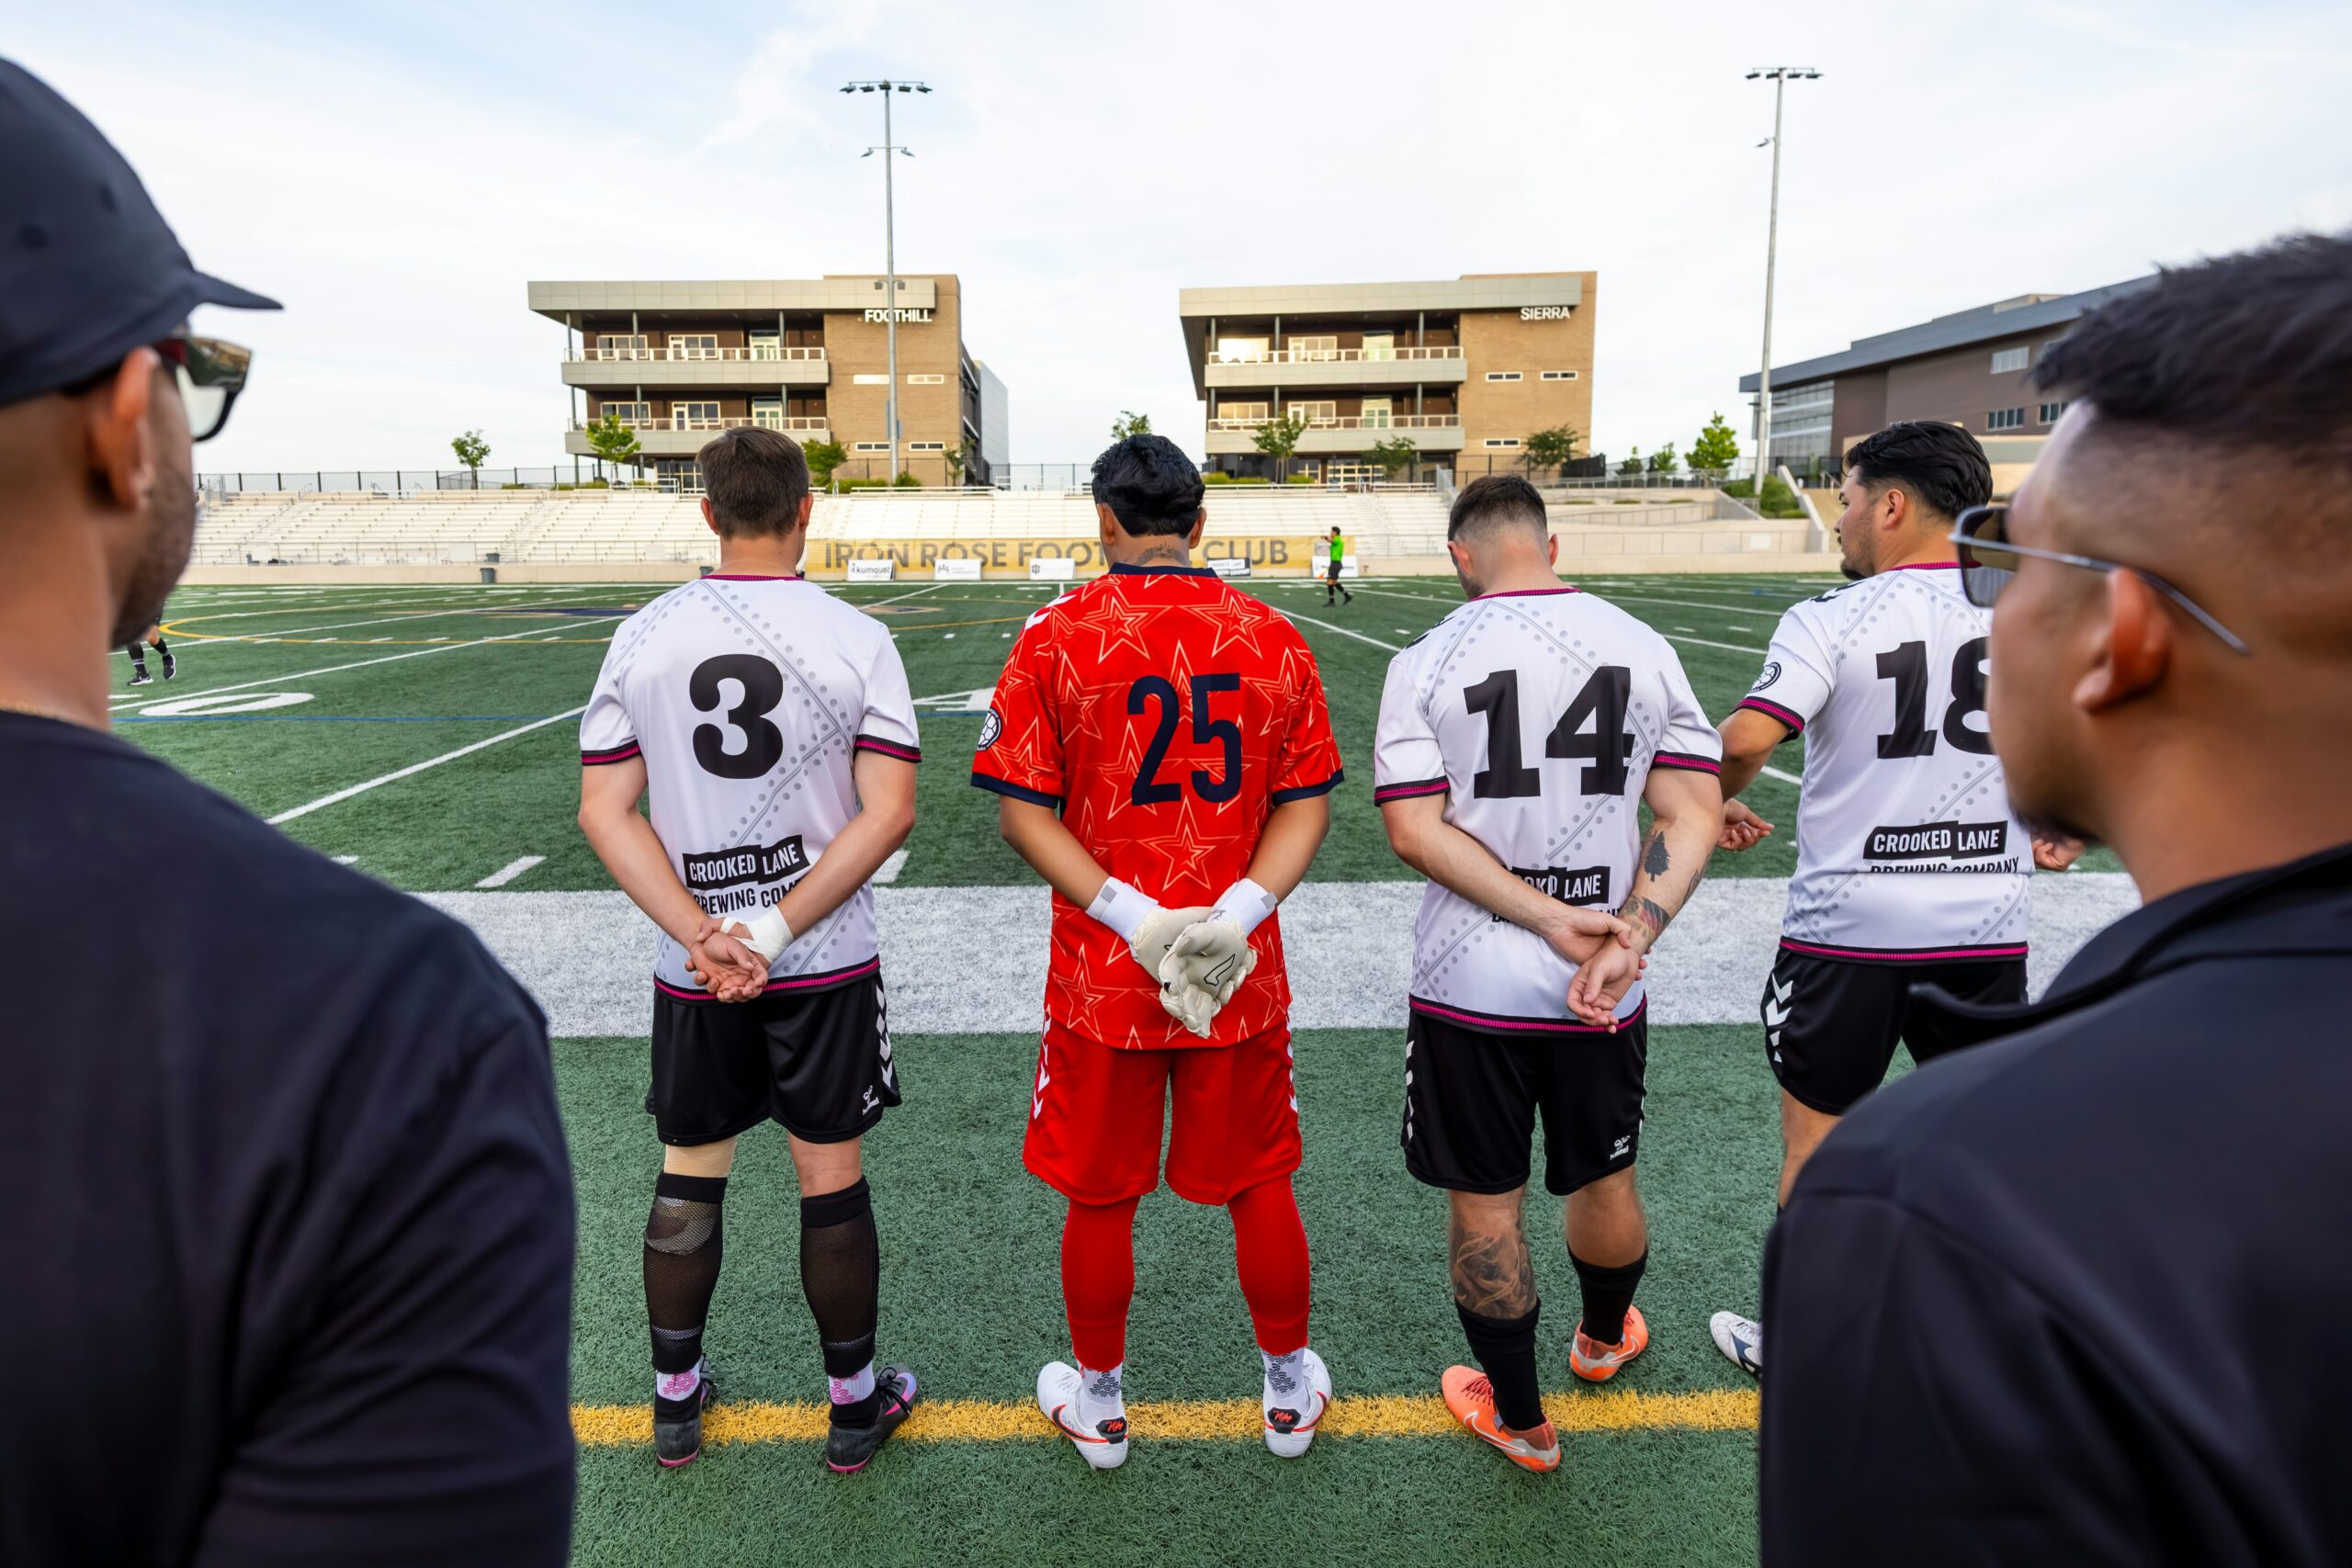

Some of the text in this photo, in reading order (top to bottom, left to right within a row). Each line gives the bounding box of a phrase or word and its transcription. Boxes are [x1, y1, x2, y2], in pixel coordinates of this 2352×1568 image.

[1521, 306, 1570, 321] SIERRA
[824, 542, 910, 569] IRON
[920, 542, 1008, 568] ROSE
[689, 653, 784, 779] 3
[1875, 636, 1999, 759] 18
[1126, 672, 1242, 806] 25
[1463, 665, 1636, 799] 14
[1873, 829, 2000, 852] CROOKED LANE
[689, 842, 800, 883] CROOKED LANE
[1564, 874, 1602, 900] LANE
